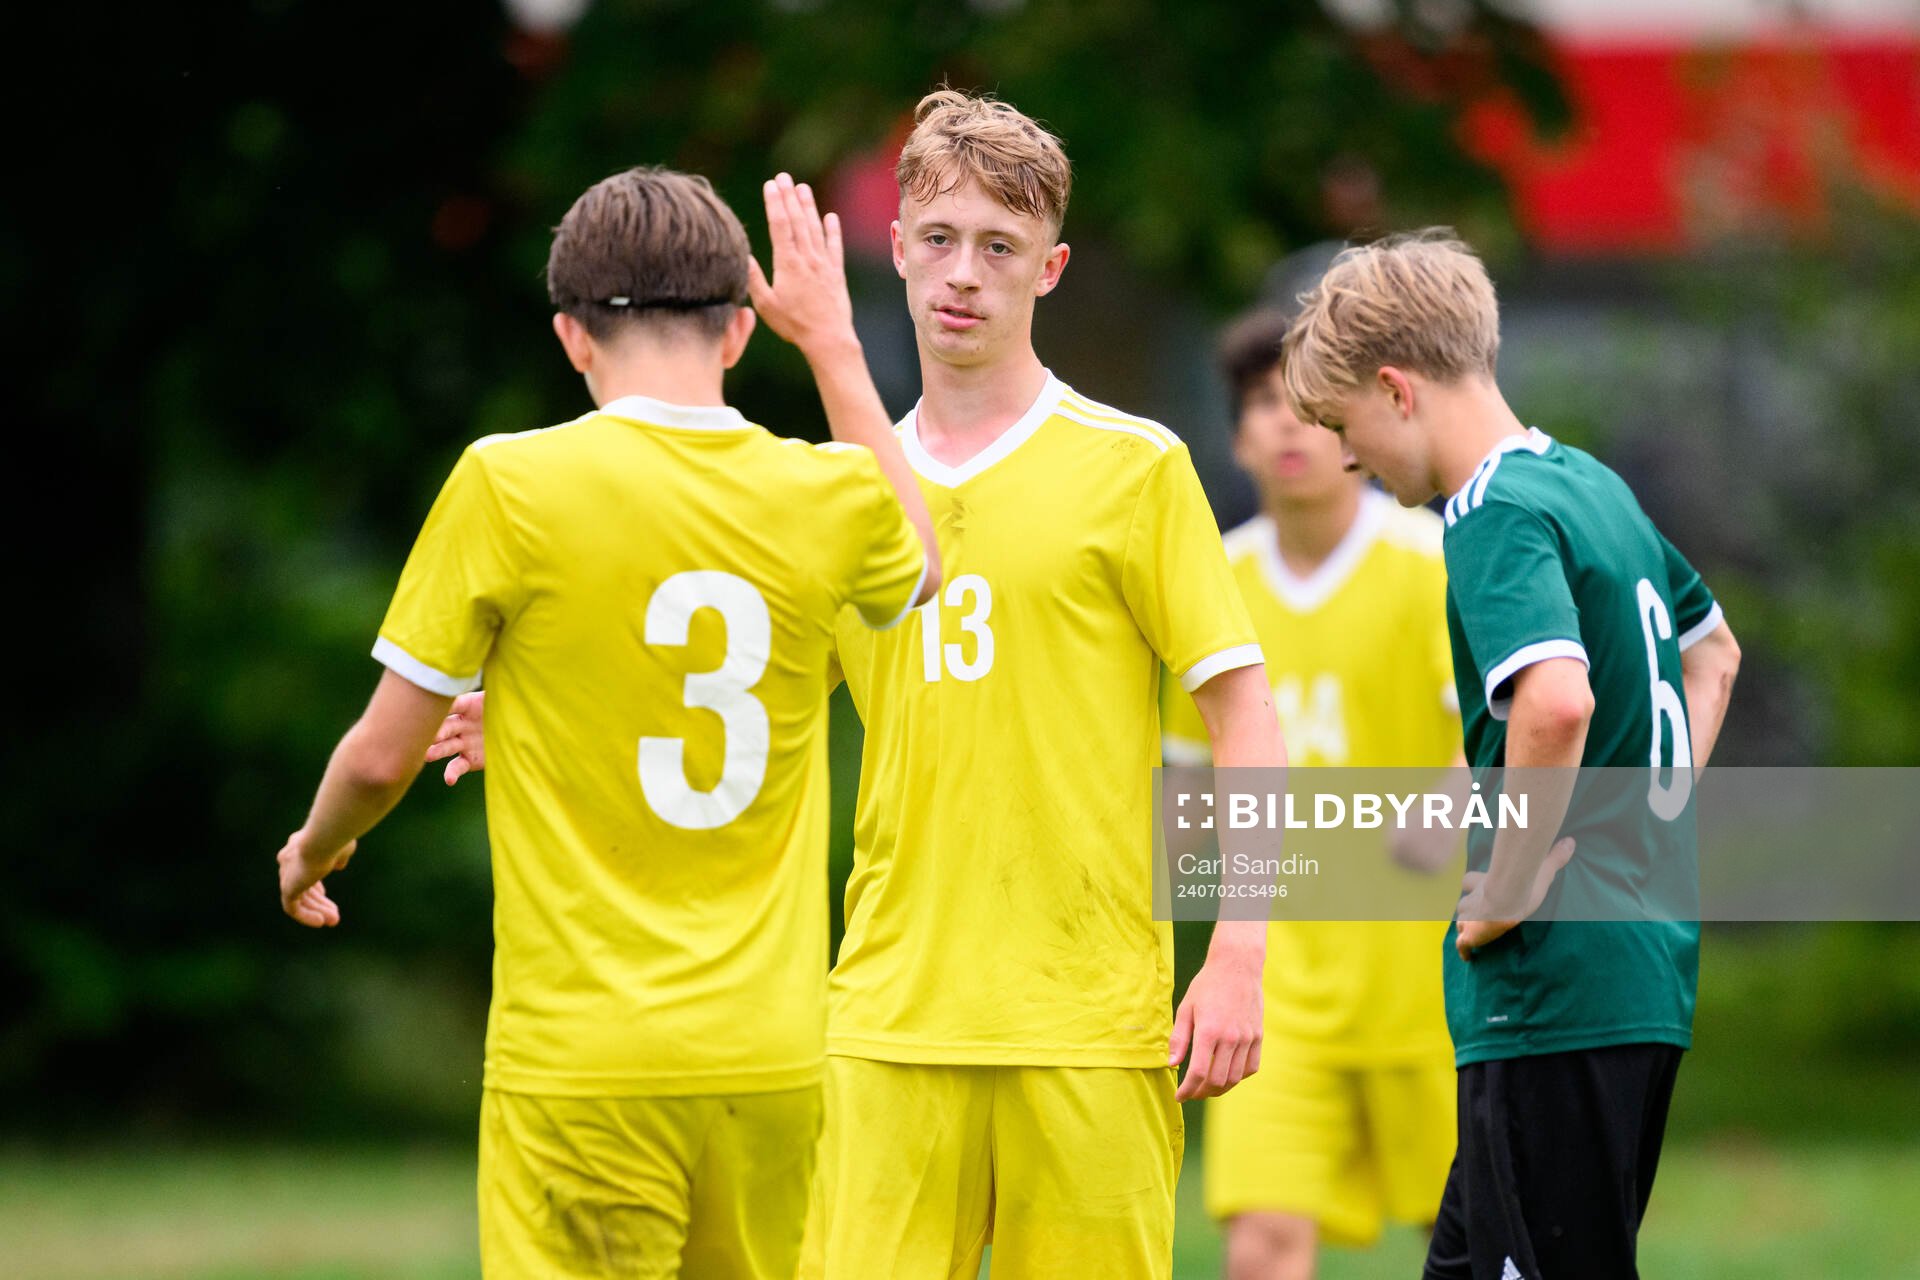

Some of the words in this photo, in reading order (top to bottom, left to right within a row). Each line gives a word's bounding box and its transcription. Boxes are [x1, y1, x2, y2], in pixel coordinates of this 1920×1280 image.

[637, 570, 771, 830] 3
[921, 573, 995, 682] 13
[1636, 578, 1693, 821] 6
